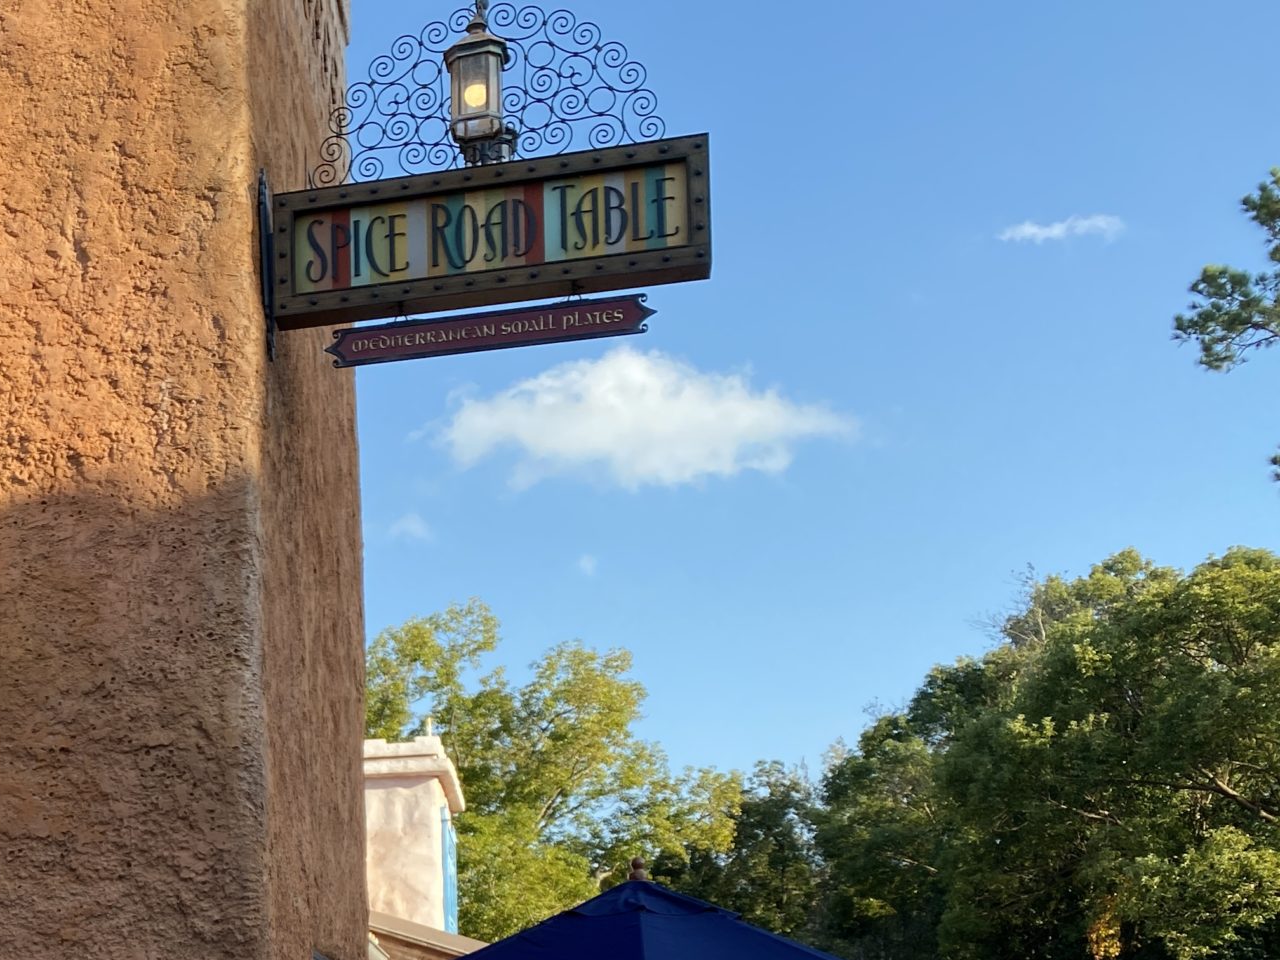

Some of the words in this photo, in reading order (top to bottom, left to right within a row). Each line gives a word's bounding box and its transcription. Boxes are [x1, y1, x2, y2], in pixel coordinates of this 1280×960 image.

[306, 214, 410, 283] SPICE
[431, 199, 538, 269] ROAD
[552, 176, 679, 252] TABLE
